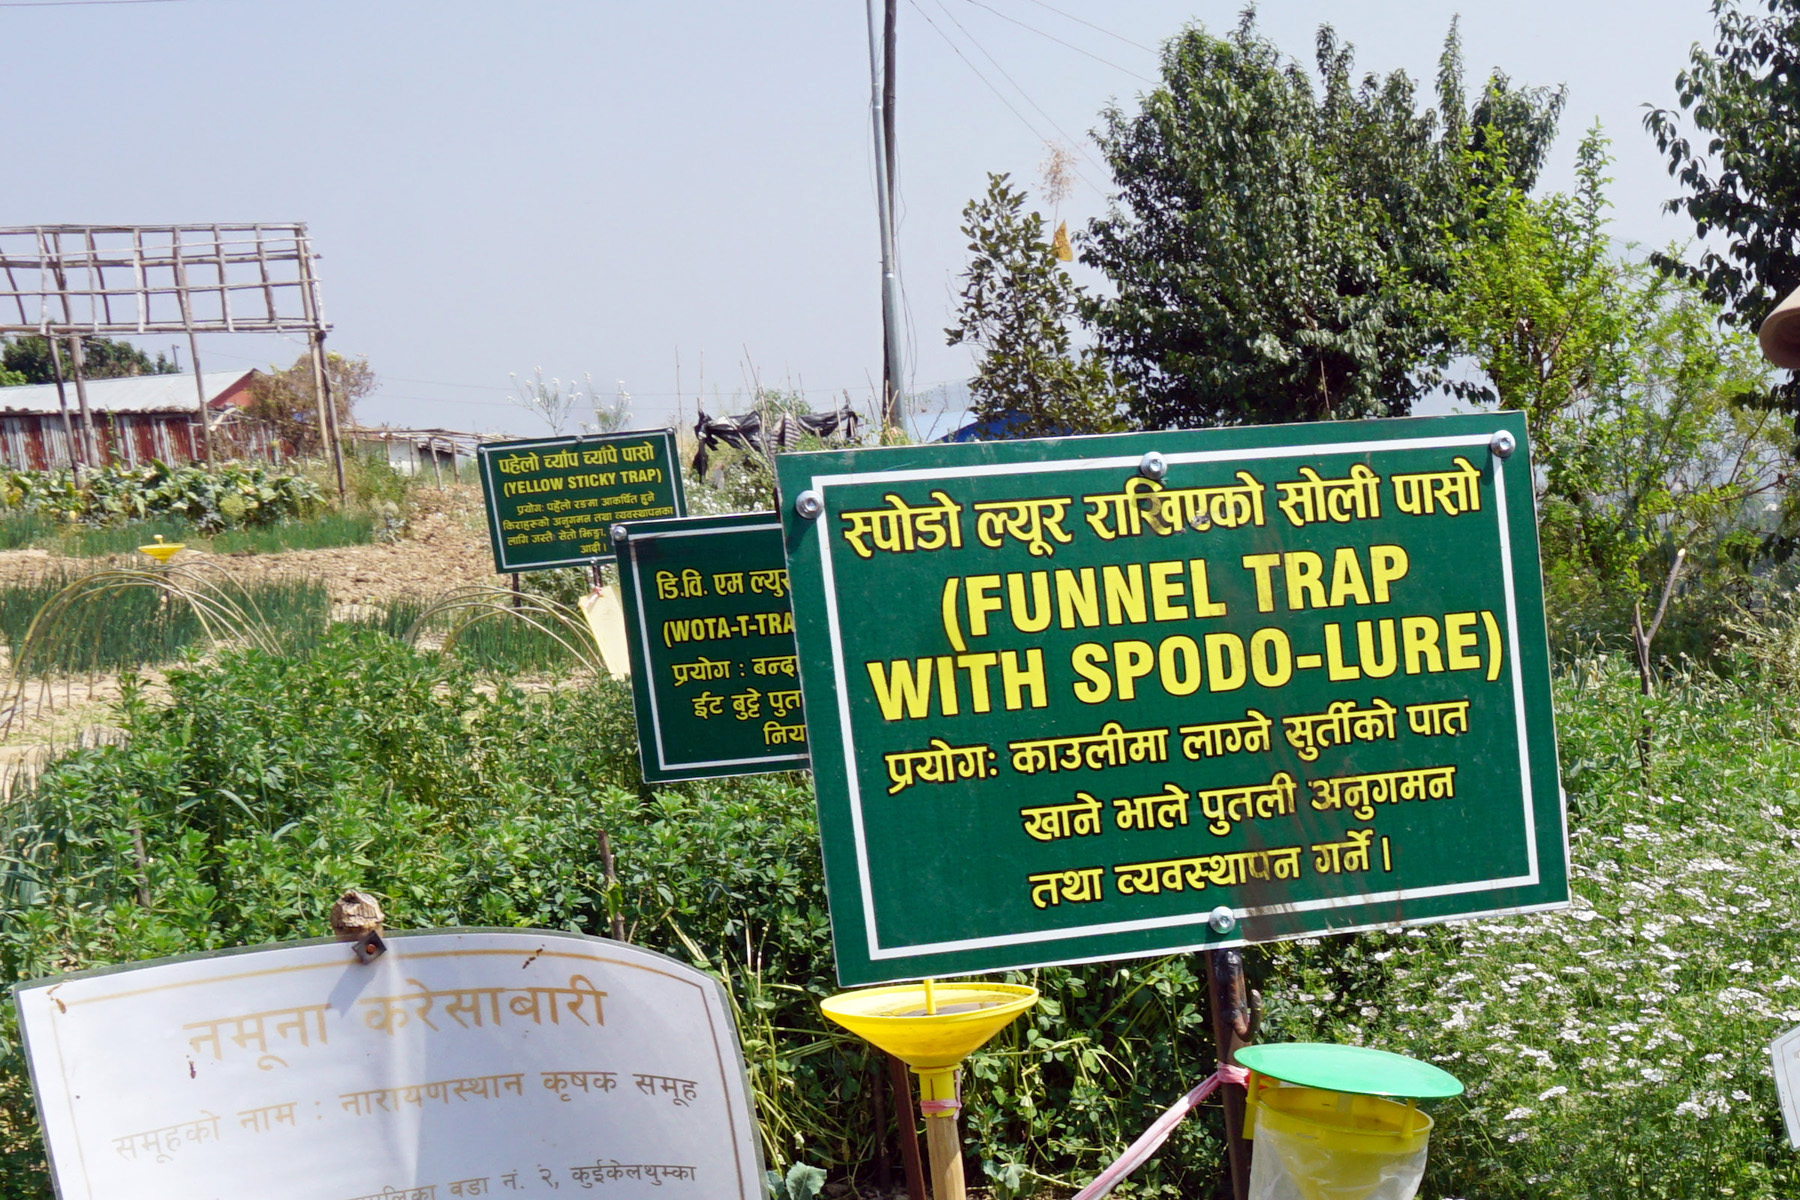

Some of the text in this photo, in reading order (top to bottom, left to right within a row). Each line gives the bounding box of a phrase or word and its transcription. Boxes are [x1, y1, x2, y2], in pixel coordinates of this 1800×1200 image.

[504, 469, 662, 497] (YELLOW STICKY TRAP)
[621, 441, 654, 462] पासो
[842, 458, 1480, 557] स्पोडो ल्यूर राखिएको सोली पासो
[713, 573, 743, 595] एम
[940, 544, 1410, 652] (FUNNEL TRAP
[672, 657, 730, 686] प्रयोग
[867, 610, 1503, 720] WITH SPODO-LURE)
[1010, 723, 1168, 772] काउलीमा
[1180, 711, 1272, 759] लाग्ने
[1283, 702, 1396, 760] सुर्तीको
[1406, 701, 1469, 734] पात
[1022, 767, 1455, 840] खाने भाले पुतली अनुगमन
[1029, 869, 1103, 907] तथा
[1115, 847, 1301, 893] व्यवस्थापन
[1313, 829, 1372, 873] गर्ने
[182, 974, 608, 1071] नमूना करेसाबारी
[112, 1110, 221, 1163] समूहको
[236, 1101, 297, 1133] नाम
[339, 1073, 525, 1117] नारायणस्थान
[541, 1071, 617, 1102] कृषक
[633, 1073, 699, 1106] समूह
[448, 1176, 490, 1198] वडा
